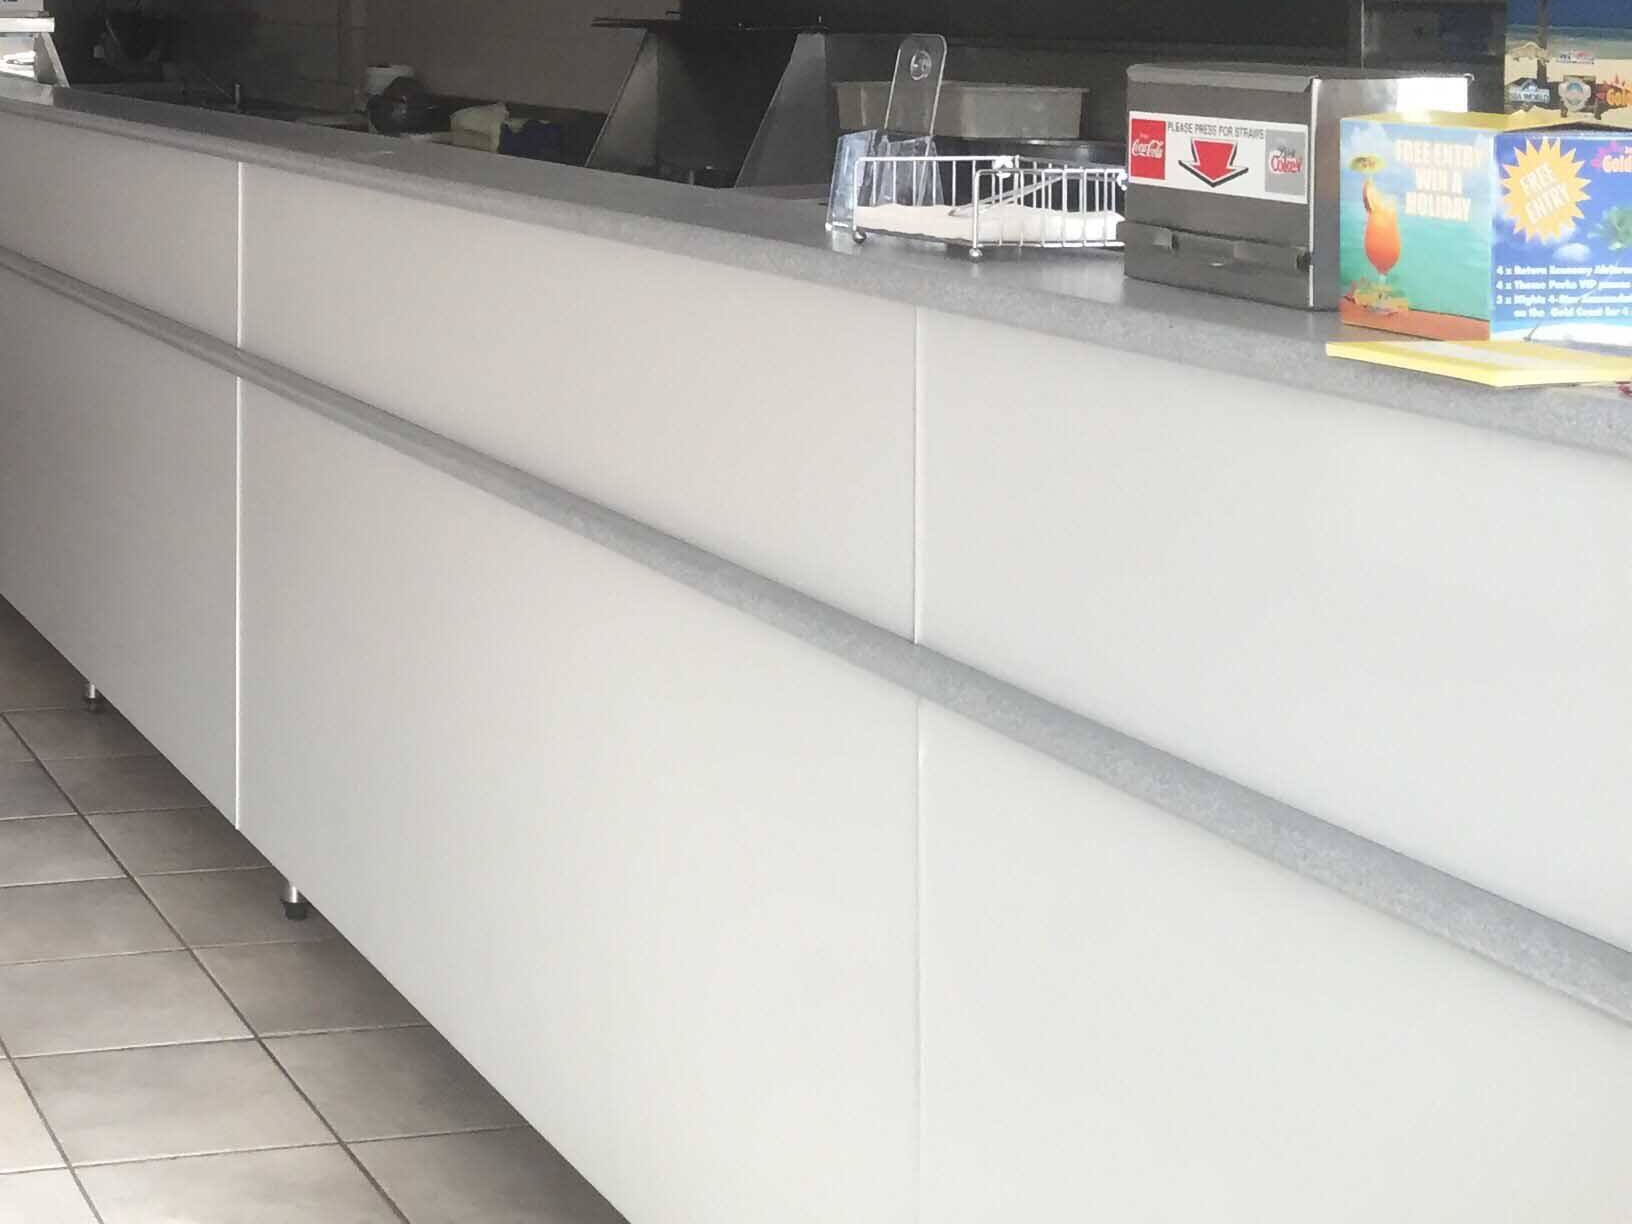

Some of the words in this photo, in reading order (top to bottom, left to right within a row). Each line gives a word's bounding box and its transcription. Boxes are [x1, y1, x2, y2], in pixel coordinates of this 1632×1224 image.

[1168, 120, 1193, 134] PLEASE
[1194, 122, 1217, 137] PRESS
[1218, 125, 1233, 137] FOR
[1234, 127, 1264, 140] STRAWS
[1405, 190, 1472, 223] HOLIDAY
[1578, 279, 1597, 290] VIP
